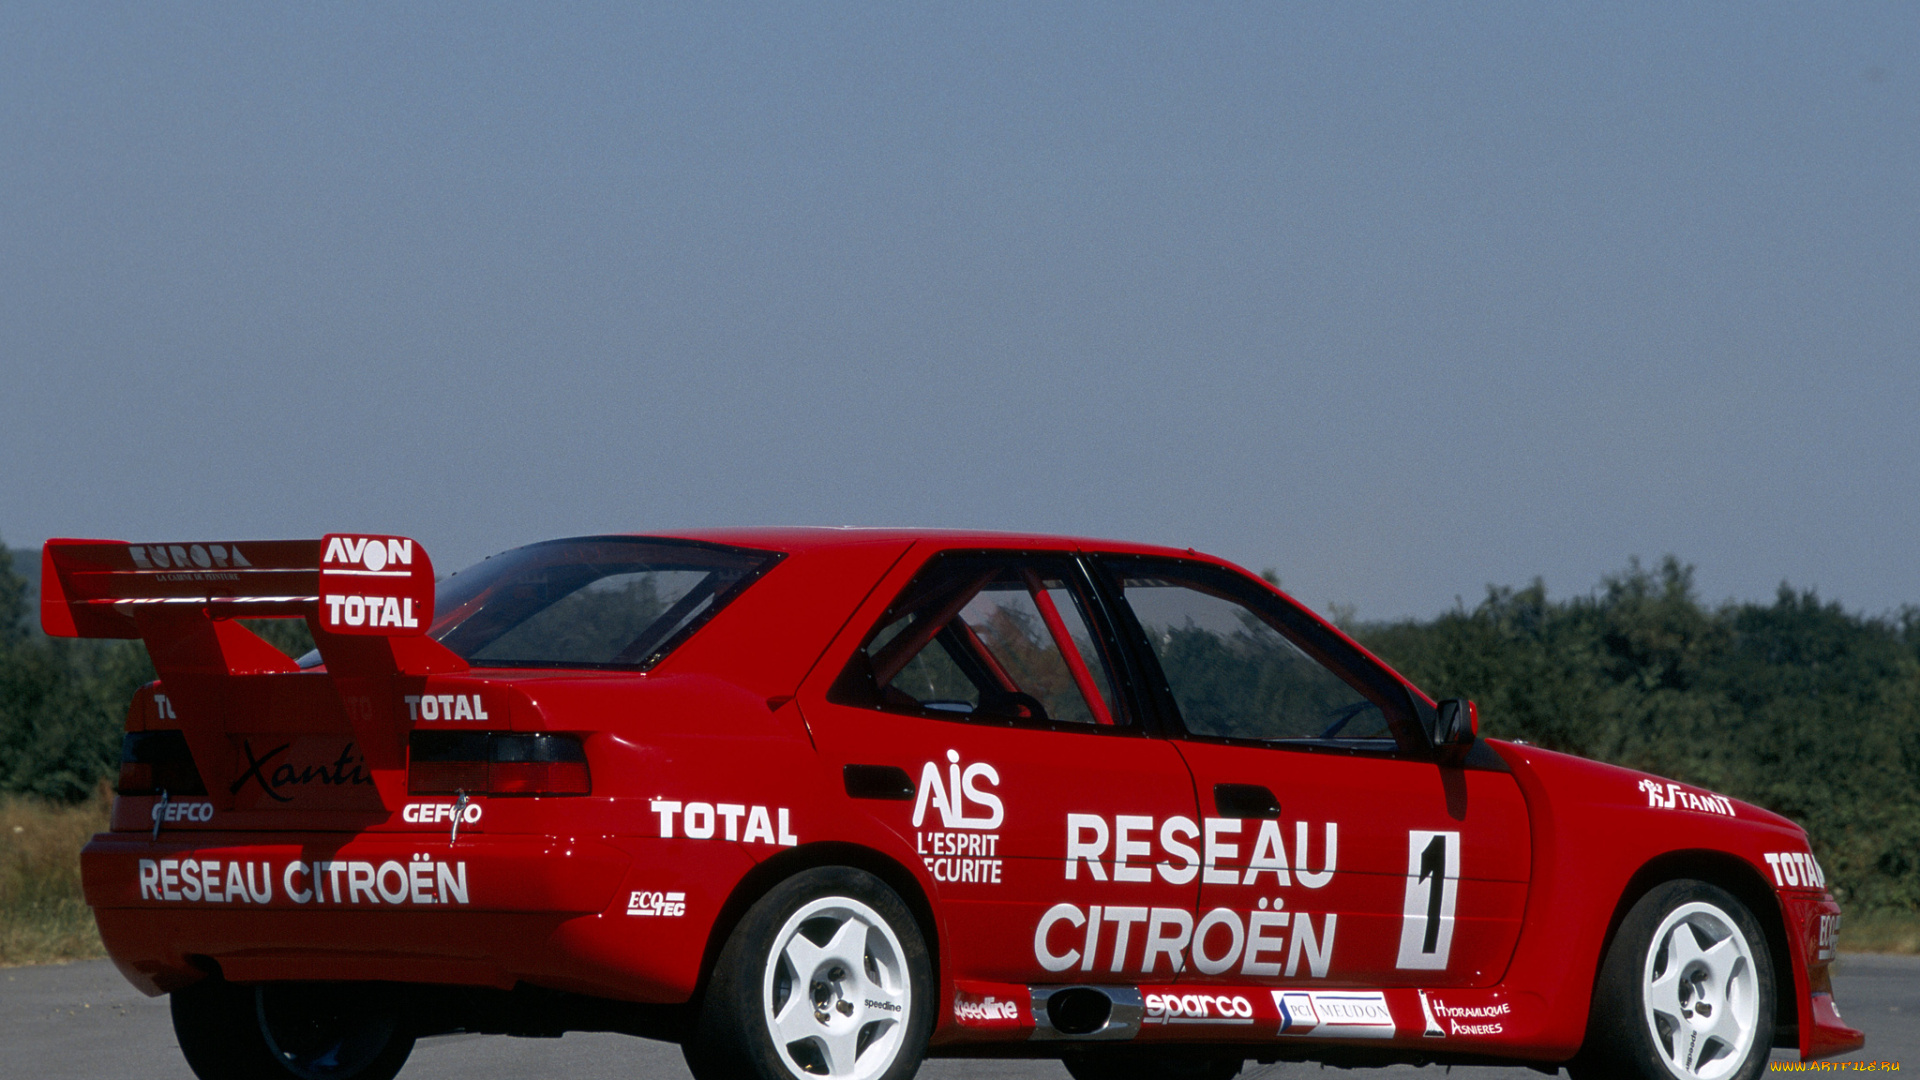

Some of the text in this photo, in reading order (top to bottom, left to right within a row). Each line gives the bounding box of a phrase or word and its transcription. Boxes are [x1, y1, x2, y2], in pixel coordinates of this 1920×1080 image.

[128, 544, 253, 569] EUROPA
[323, 537, 412, 571] AVON
[325, 594, 418, 628] TOTAL
[404, 694, 488, 720] TOTAL
[229, 739, 373, 802] Xanti
[151, 802, 213, 822] GEFCO
[651, 801, 798, 847] TOTAL
[917, 832, 999, 857] L'ESPRIT
[1064, 812, 1338, 889] RESEAU
[139, 852, 470, 905] RESEAU CITROËN
[1418, 834, 1447, 955] 1
[1034, 896, 1338, 978] CITROËN
[864, 998, 902, 1012] speedline
[1145, 994, 1253, 1025] sparco
[1290, 1004, 1389, 1018] PCI MEUDON
[1433, 999, 1511, 1018] HYDRAULIQUE
[1450, 1017, 1503, 1036] ASNIERES
[1685, 1029, 1698, 1071] speedlin
